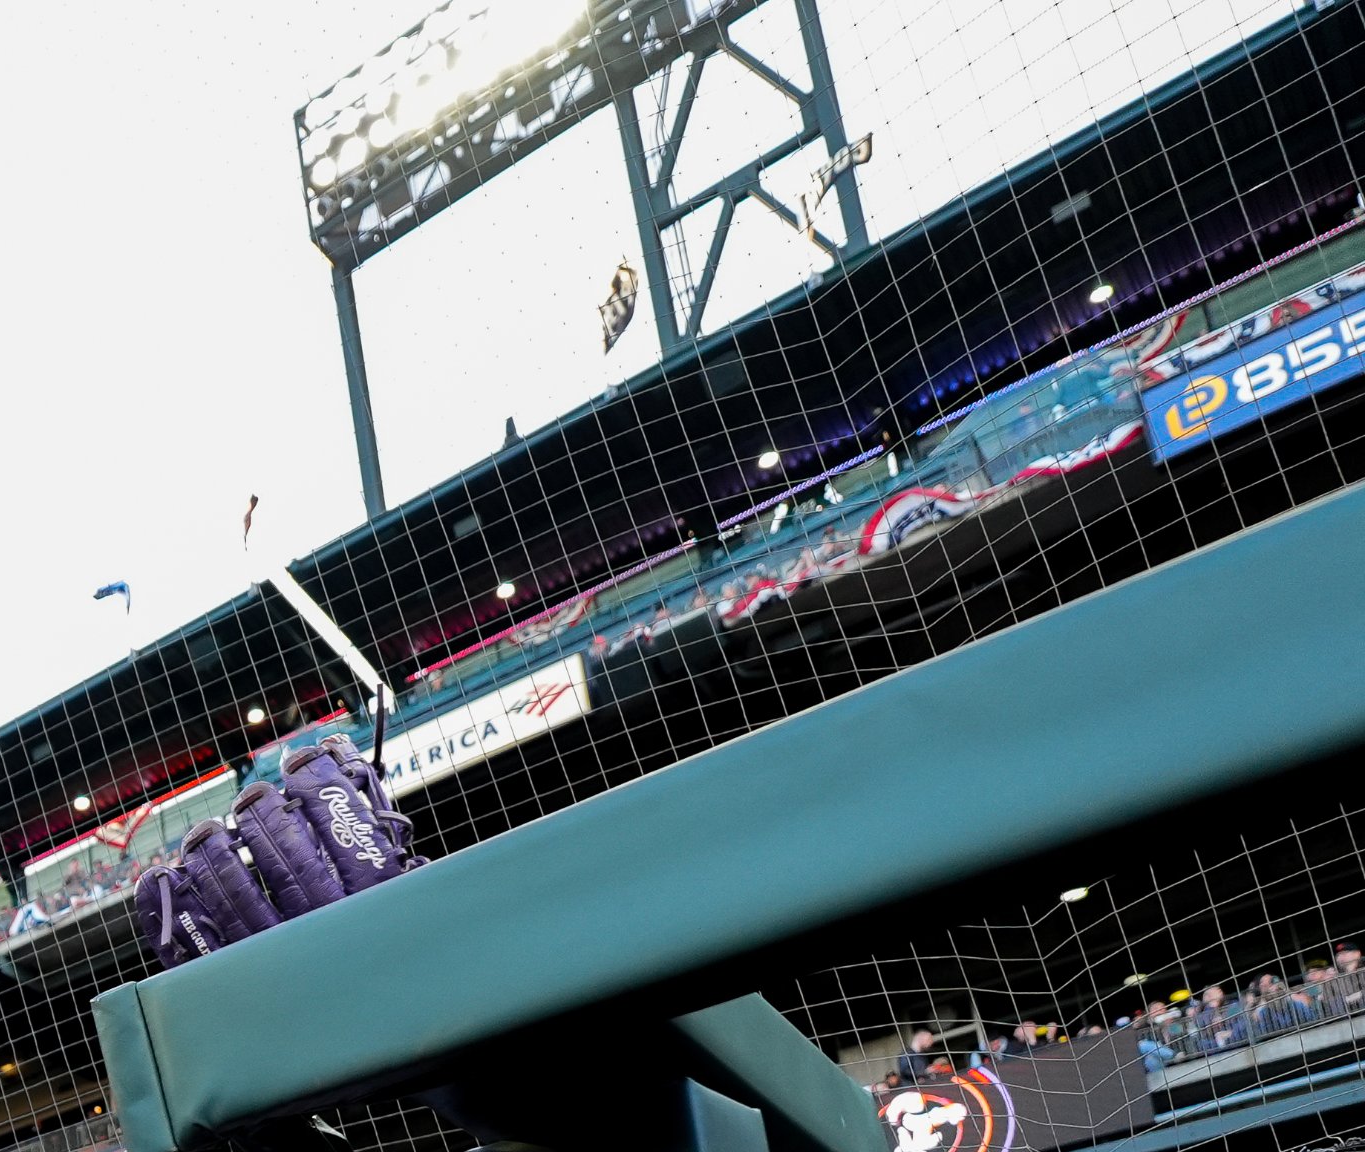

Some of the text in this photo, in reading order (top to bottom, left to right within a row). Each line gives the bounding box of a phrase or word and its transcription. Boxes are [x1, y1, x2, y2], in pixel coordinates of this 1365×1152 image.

[384, 719, 499, 786] MERICA
[319, 786, 386, 869] Rawlings
[179, 911, 197, 934] THE
